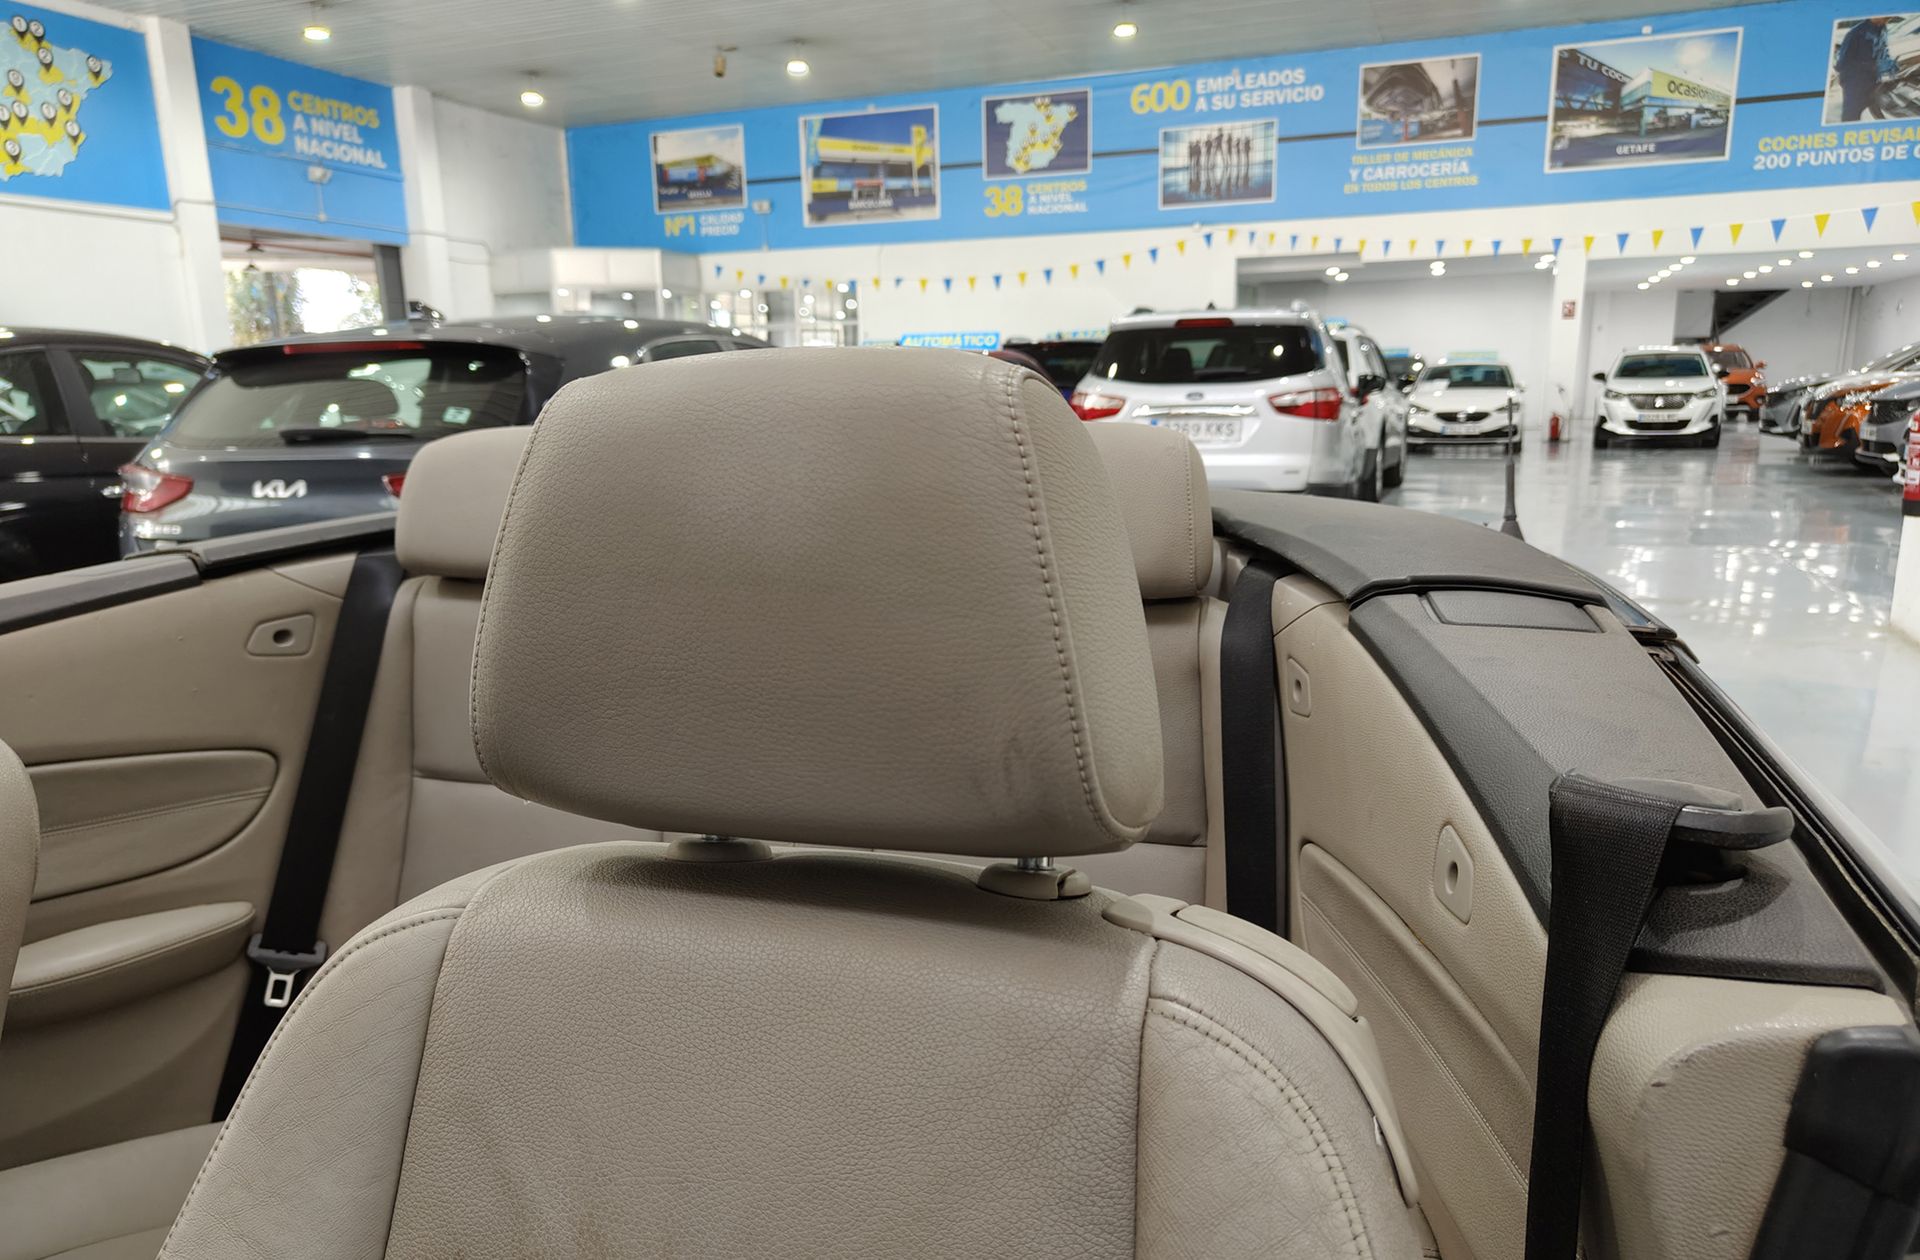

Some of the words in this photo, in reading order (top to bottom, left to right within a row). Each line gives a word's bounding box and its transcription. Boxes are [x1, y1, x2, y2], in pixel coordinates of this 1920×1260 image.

[1576, 53, 1598, 71] TU
[1196, 68, 1305, 94] EMPLEADOS
[287, 90, 380, 128] CENTROS
[1130, 80, 1191, 114] 600
[1195, 97, 1208, 112] A
[1212, 95, 1236, 110] SU
[1240, 85, 1324, 107] SERVICIO
[210, 76, 286, 145] 38
[293, 114, 308, 133] A
[310, 118, 363, 144] NIVEL
[294, 135, 387, 169] NACIONAL
[1616, 143, 1656, 155] GETAFE
[1758, 132, 1838, 152] COCHES
[1753, 154, 1791, 170] 200
[1796, 147, 1875, 167] PUNTOS
[1880, 145, 1908, 160] DE
[1349, 168, 1360, 182] Y
[1363, 159, 1470, 180] CARROCERÍA
[1425, 175, 1478, 188] CENTROS
[1027, 180, 1087, 194] CENTROS
[1040, 192, 1073, 203] NIVEL
[984, 185, 1023, 217] 38
[1027, 201, 1088, 214] NACIONAL
[252, 479, 307, 498] KIA
